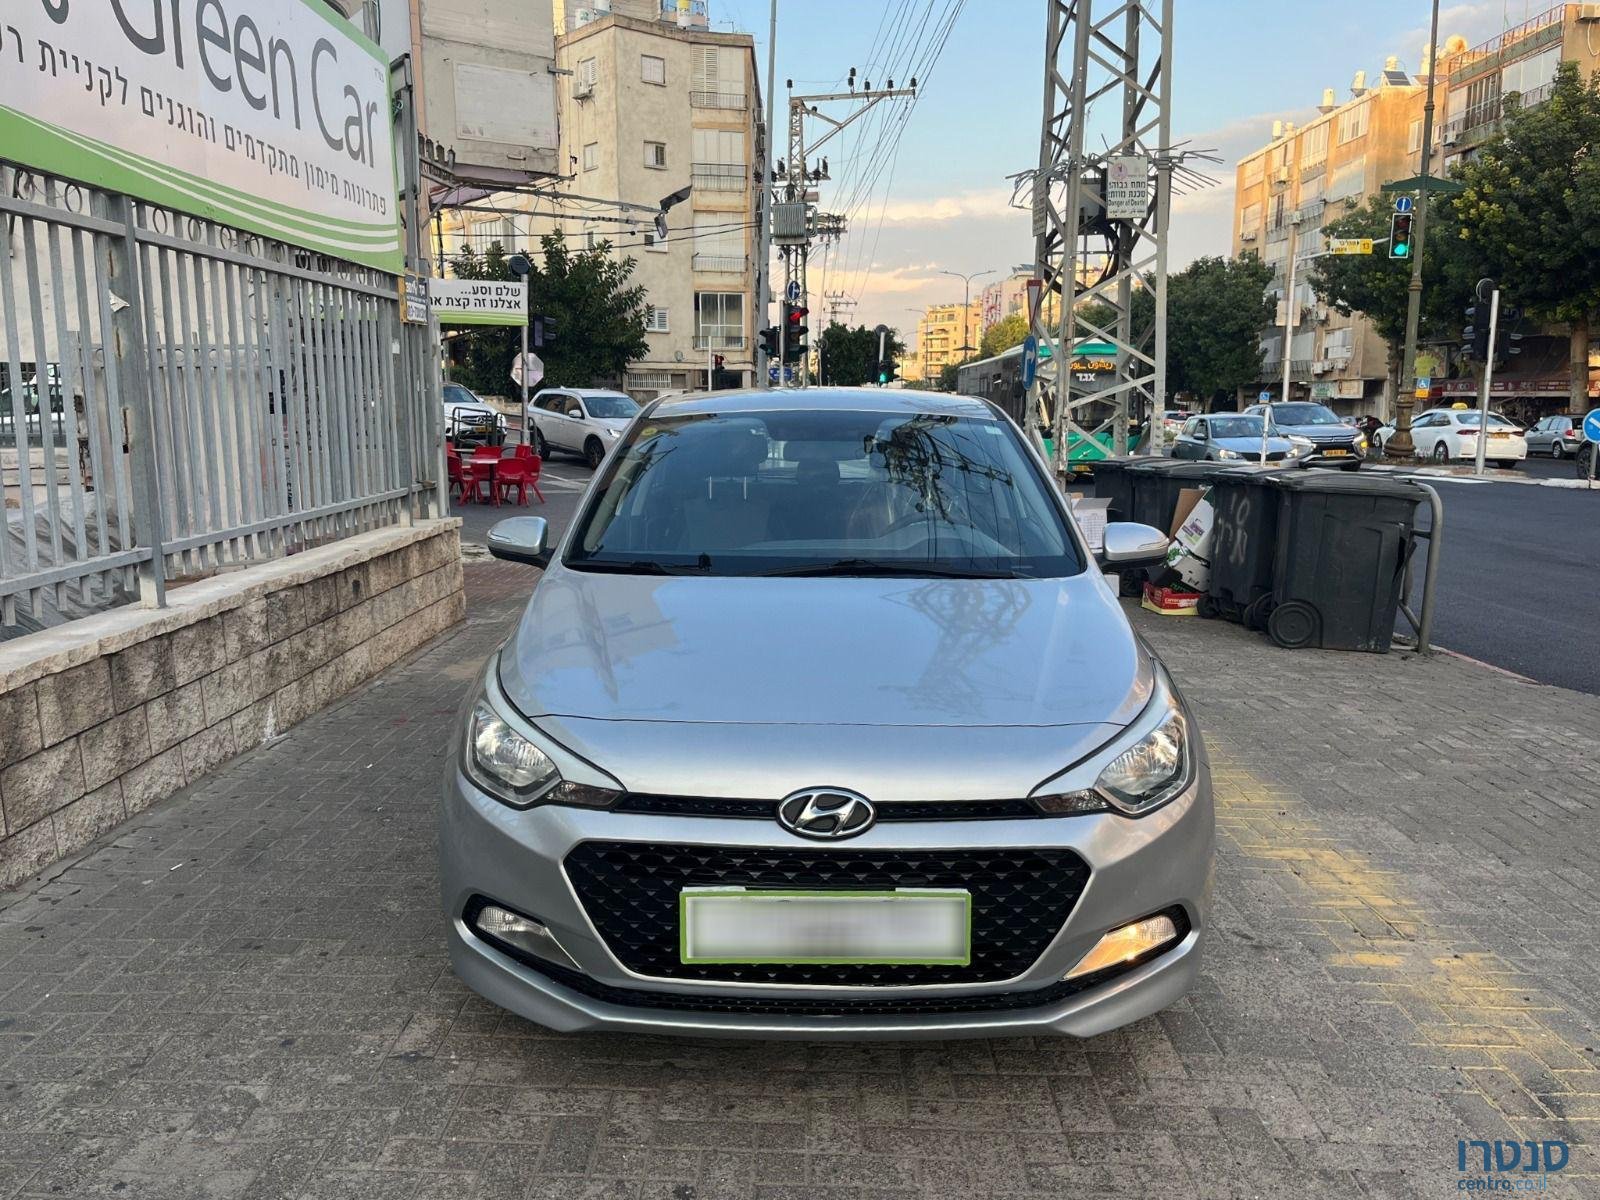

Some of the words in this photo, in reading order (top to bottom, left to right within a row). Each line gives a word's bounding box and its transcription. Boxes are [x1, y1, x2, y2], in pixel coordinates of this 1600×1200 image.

[0, 23, 24, 63] ר
[38, 39, 128, 106] לקניית
[140, 86, 216, 143] והוגנים
[311, 37, 378, 169] Car
[224, 124, 299, 178] מתקדמים
[304, 160, 339, 195] מימון
[343, 179, 386, 215] פתרונות
[445, 296, 470, 309] קצת
[460, 285, 492, 295] וסע...
[474, 298, 486, 308] זה
[490, 297, 521, 309] אצלנו
[495, 284, 521, 297] שלם
[1076, 372, 1096, 382] אגד
